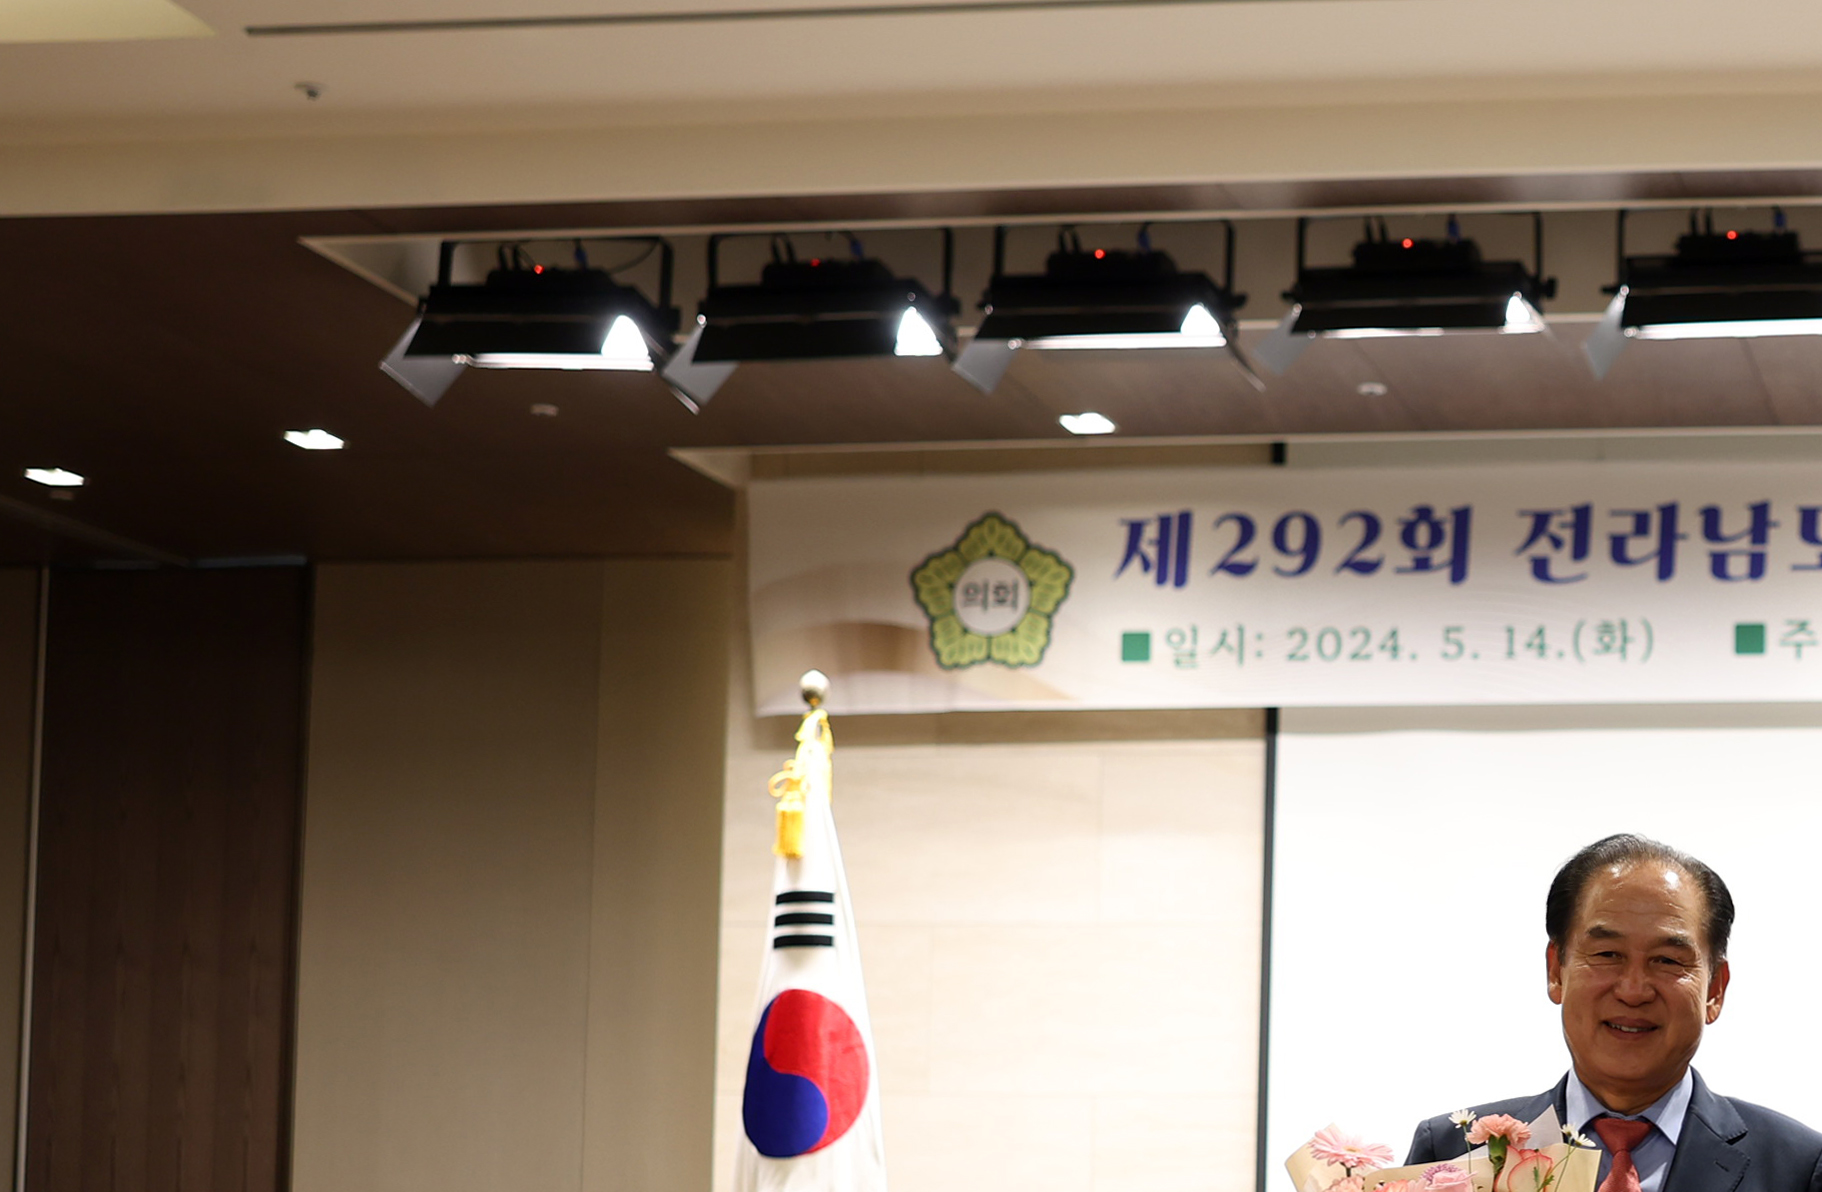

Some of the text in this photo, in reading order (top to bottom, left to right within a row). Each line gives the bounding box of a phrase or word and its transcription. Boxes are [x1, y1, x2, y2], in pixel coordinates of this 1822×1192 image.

[1112, 503, 1473, 589] 제292회
[961, 577, 1019, 613] 의회
[1164, 617, 1654, 669] 일시: 2024. 5. 14.(화)
